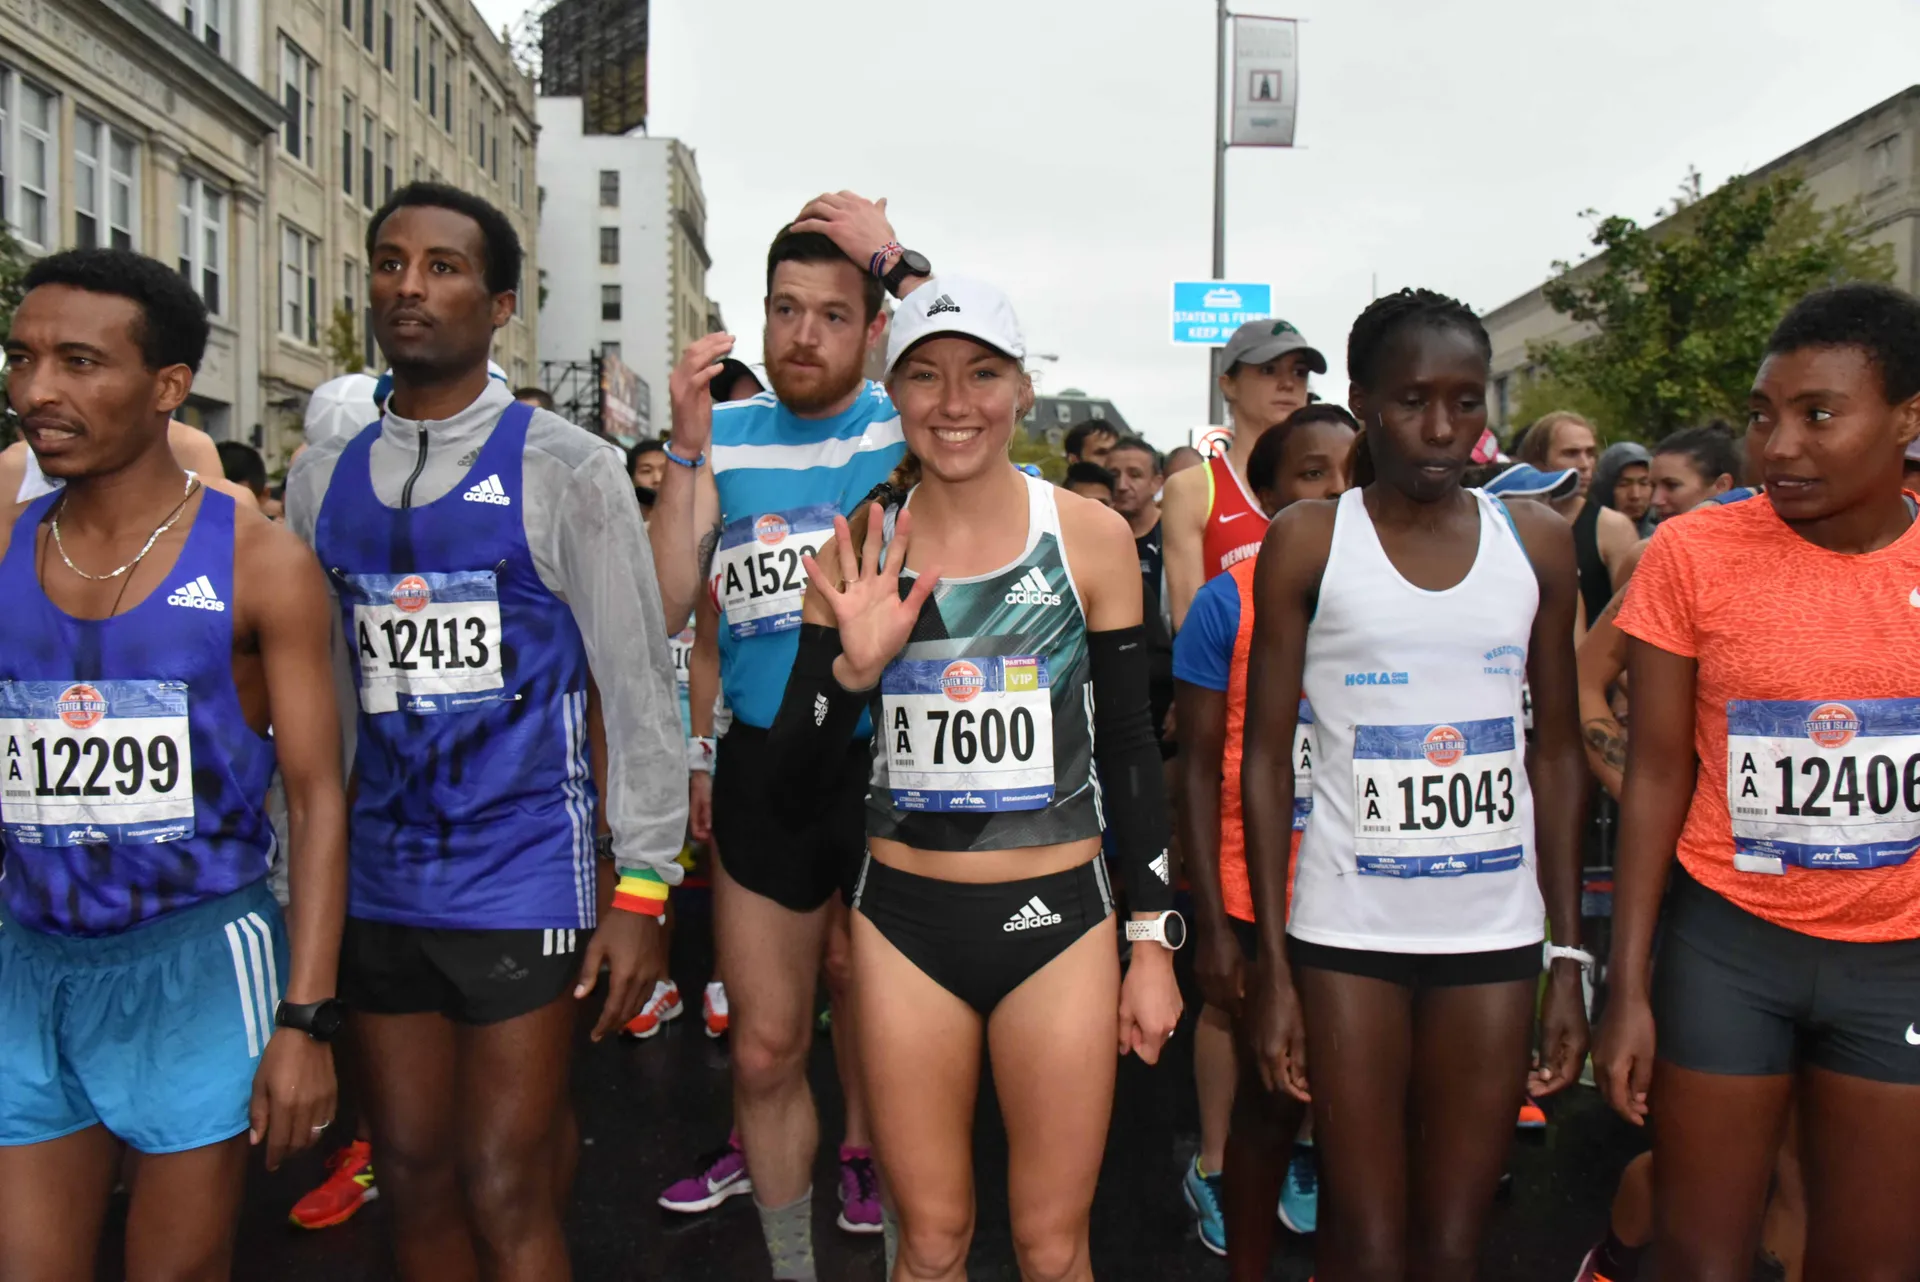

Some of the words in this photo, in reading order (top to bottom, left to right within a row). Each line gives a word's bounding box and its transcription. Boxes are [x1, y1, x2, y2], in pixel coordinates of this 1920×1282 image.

[927, 304, 961, 317] adidas
[1174, 311, 1217, 323] STATEN
[1218, 311, 1230, 323] IS
[1188, 327, 1219, 339] KEEP
[463, 491, 511, 506] adidas
[726, 562, 744, 596] A
[167, 594, 225, 612] adidas
[1004, 590, 1062, 606] adidas
[359, 620, 378, 659] A
[381, 616, 489, 670] 12413
[1005, 657, 1036, 666] PARTNER
[1011, 674, 1033, 685] VIP
[1345, 672, 1391, 686] HOKA
[1484, 667, 1511, 675] TRACK
[940, 678, 961, 688] STATEN
[963, 677, 984, 687] ISLAND
[57, 702, 80, 713] STATEN
[82, 701, 106, 712] SLAND
[894, 706, 910, 729] A
[1806, 720, 1832, 732] STATEN
[1833, 720, 1859, 730] ISLAND
[896, 730, 912, 753] A
[927, 706, 1035, 765] 7600
[7, 735, 21, 757] A
[1301, 737, 1311, 753] A
[1422, 741, 1444, 753] STATEN
[1445, 740, 1466, 751] ISLAND
[9, 759, 22, 780] A
[32, 735, 179, 797] 12299
[1301, 754, 1311, 769] A
[1740, 752, 1757, 774] A
[1364, 777, 1379, 798] A
[1741, 776, 1759, 798] A
[1775, 753, 1920, 817] 12406
[1397, 767, 1515, 831] 15043
[1366, 799, 1382, 820] A
[1812, 848, 1858, 860] NYRR
[1003, 913, 1062, 932] adidas
